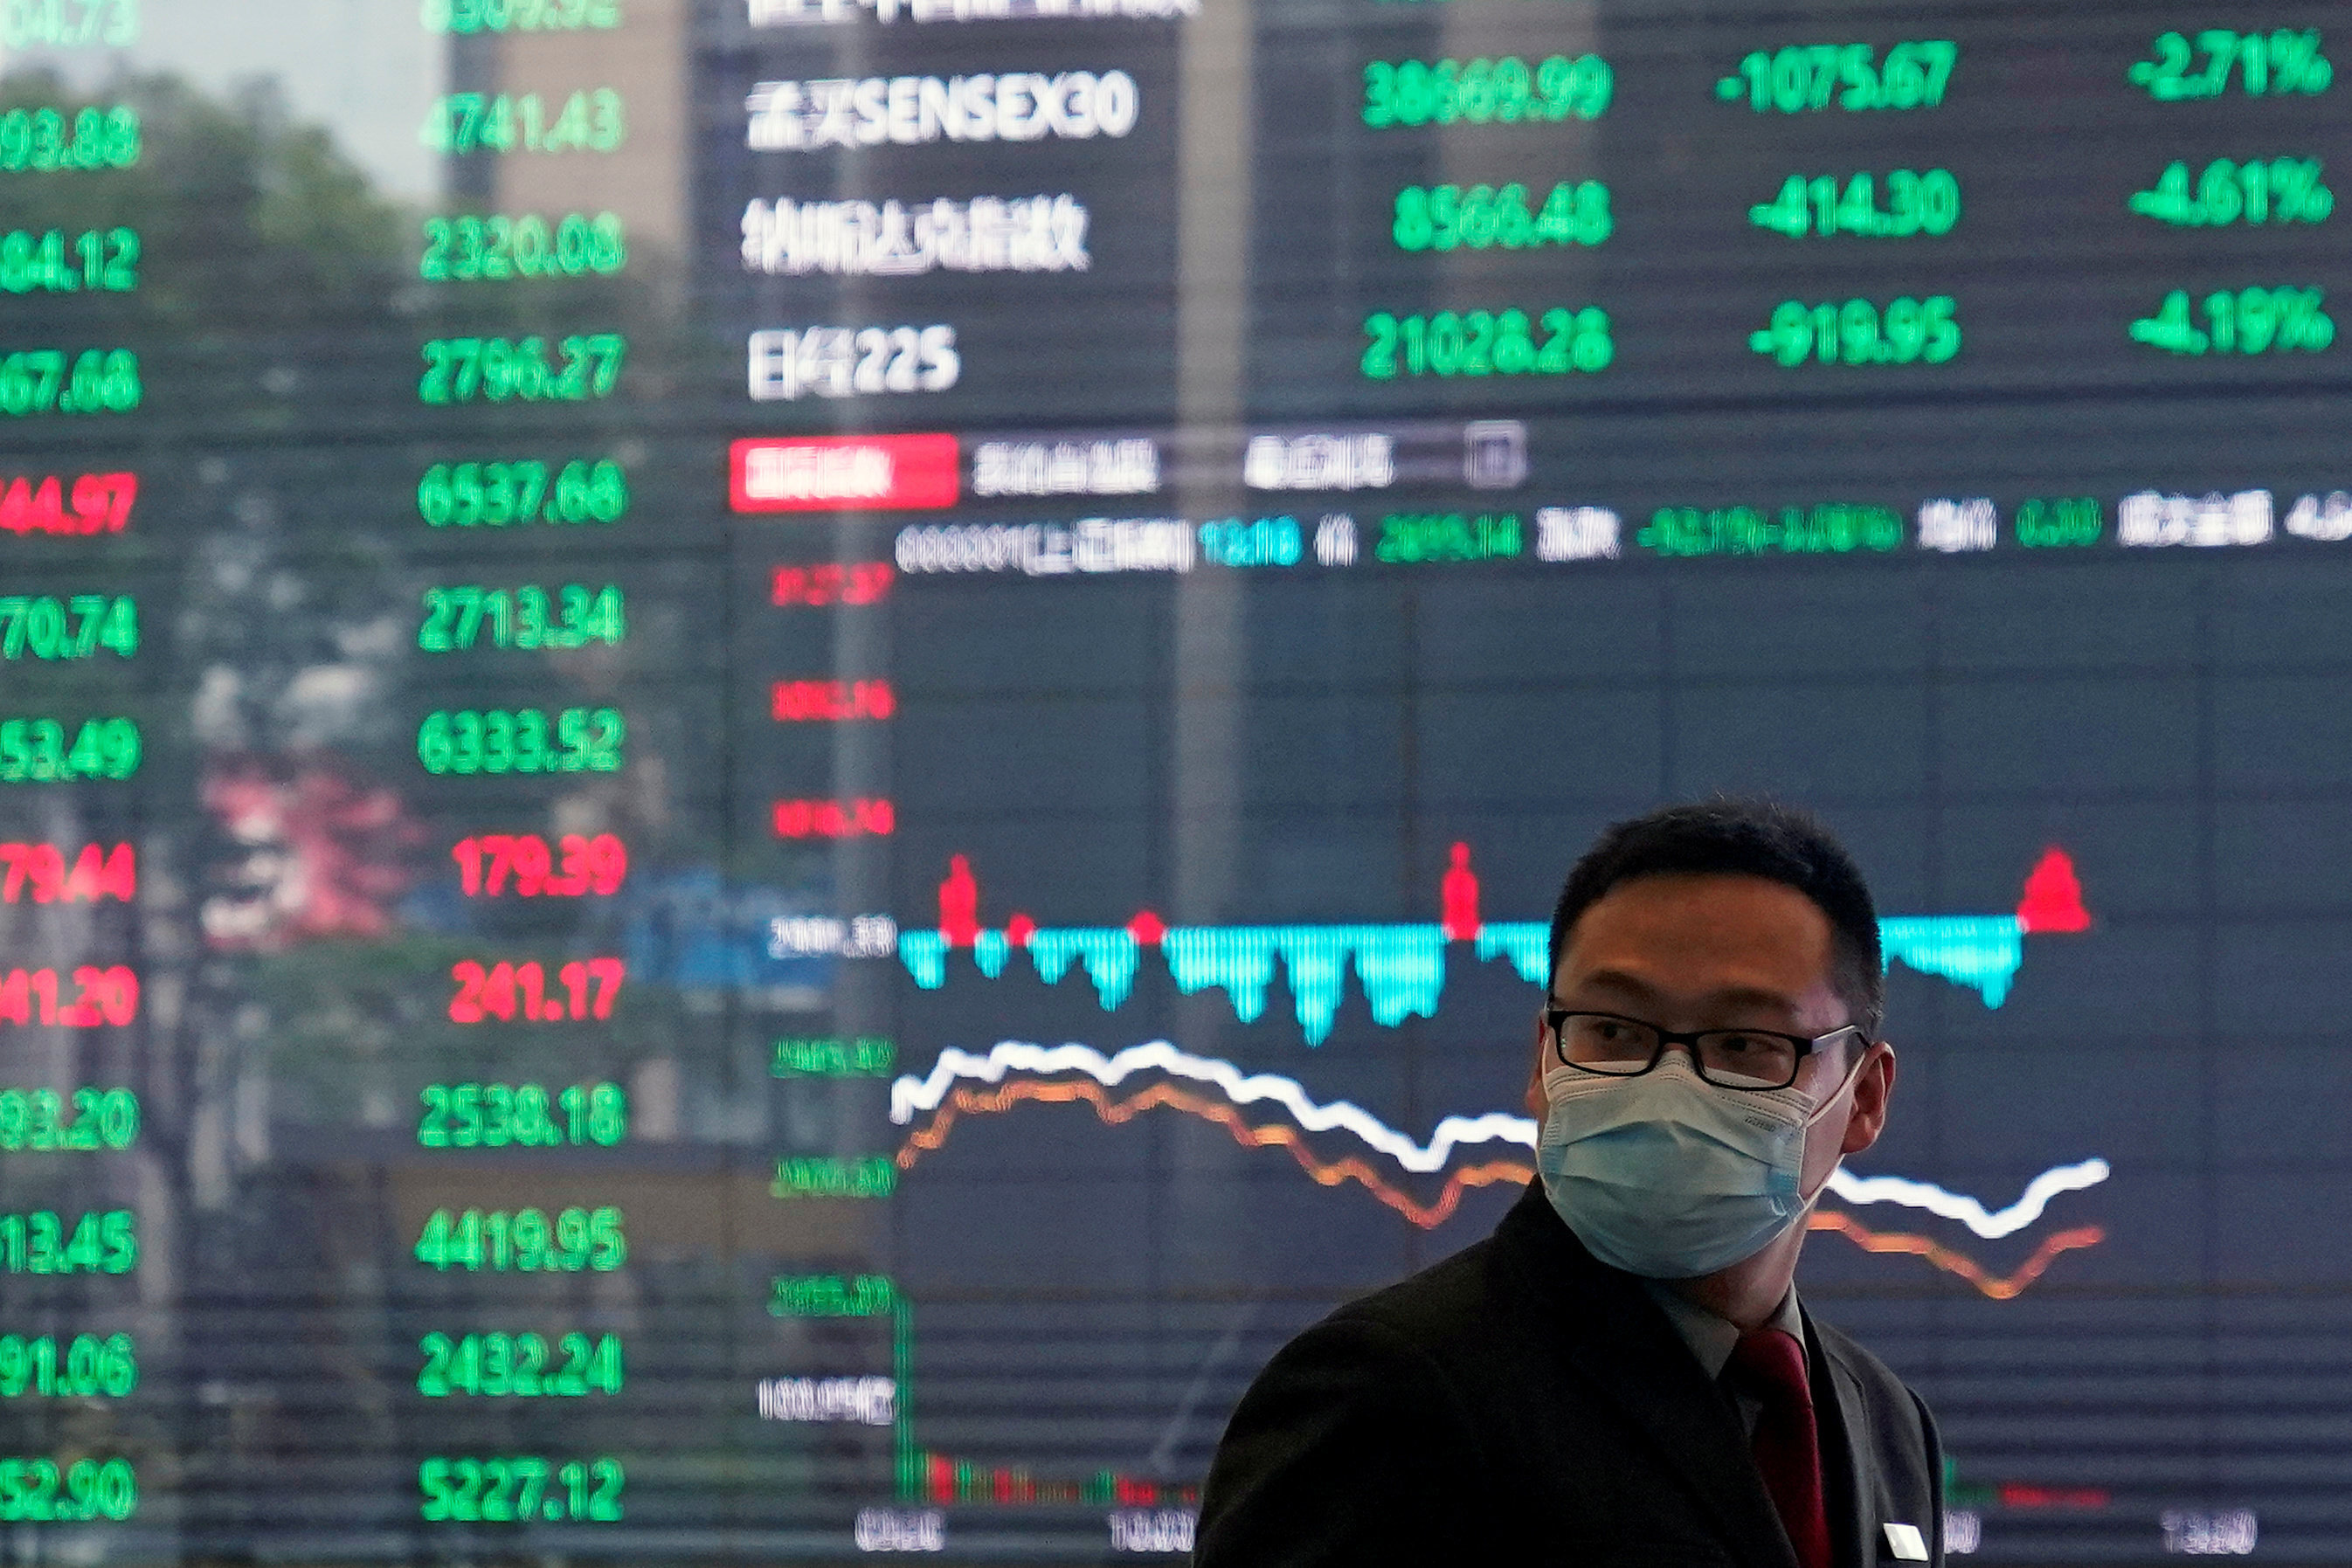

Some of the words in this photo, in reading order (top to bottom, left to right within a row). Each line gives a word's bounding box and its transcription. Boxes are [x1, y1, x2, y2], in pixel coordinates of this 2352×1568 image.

[1716, 41, 1957, 113] -1075.67
[2128, 30, 2333, 100] -2.71%
[421, 89, 622, 154] 4741.43
[1748, 169, 1962, 238] -414.30
[2128, 157, 2334, 226] -4.61%
[1361, 307, 1615, 380] 21028.28
[1748, 296, 1962, 367] -919.95
[2128, 287, 2335, 355] -4.19%
[0, 473, 137, 535] 44.97
[0, 594, 140, 660] 70.74
[418, 584, 625, 653] 2713.34
[418, 707, 625, 776] 6333.52
[0, 843, 135, 903] 79.44
[453, 834, 627, 896] 179.39
[449, 958, 624, 1023] 241.17
[417, 1331, 623, 1397] 2432.24
[419, 1456, 624, 1522] 5227.12
